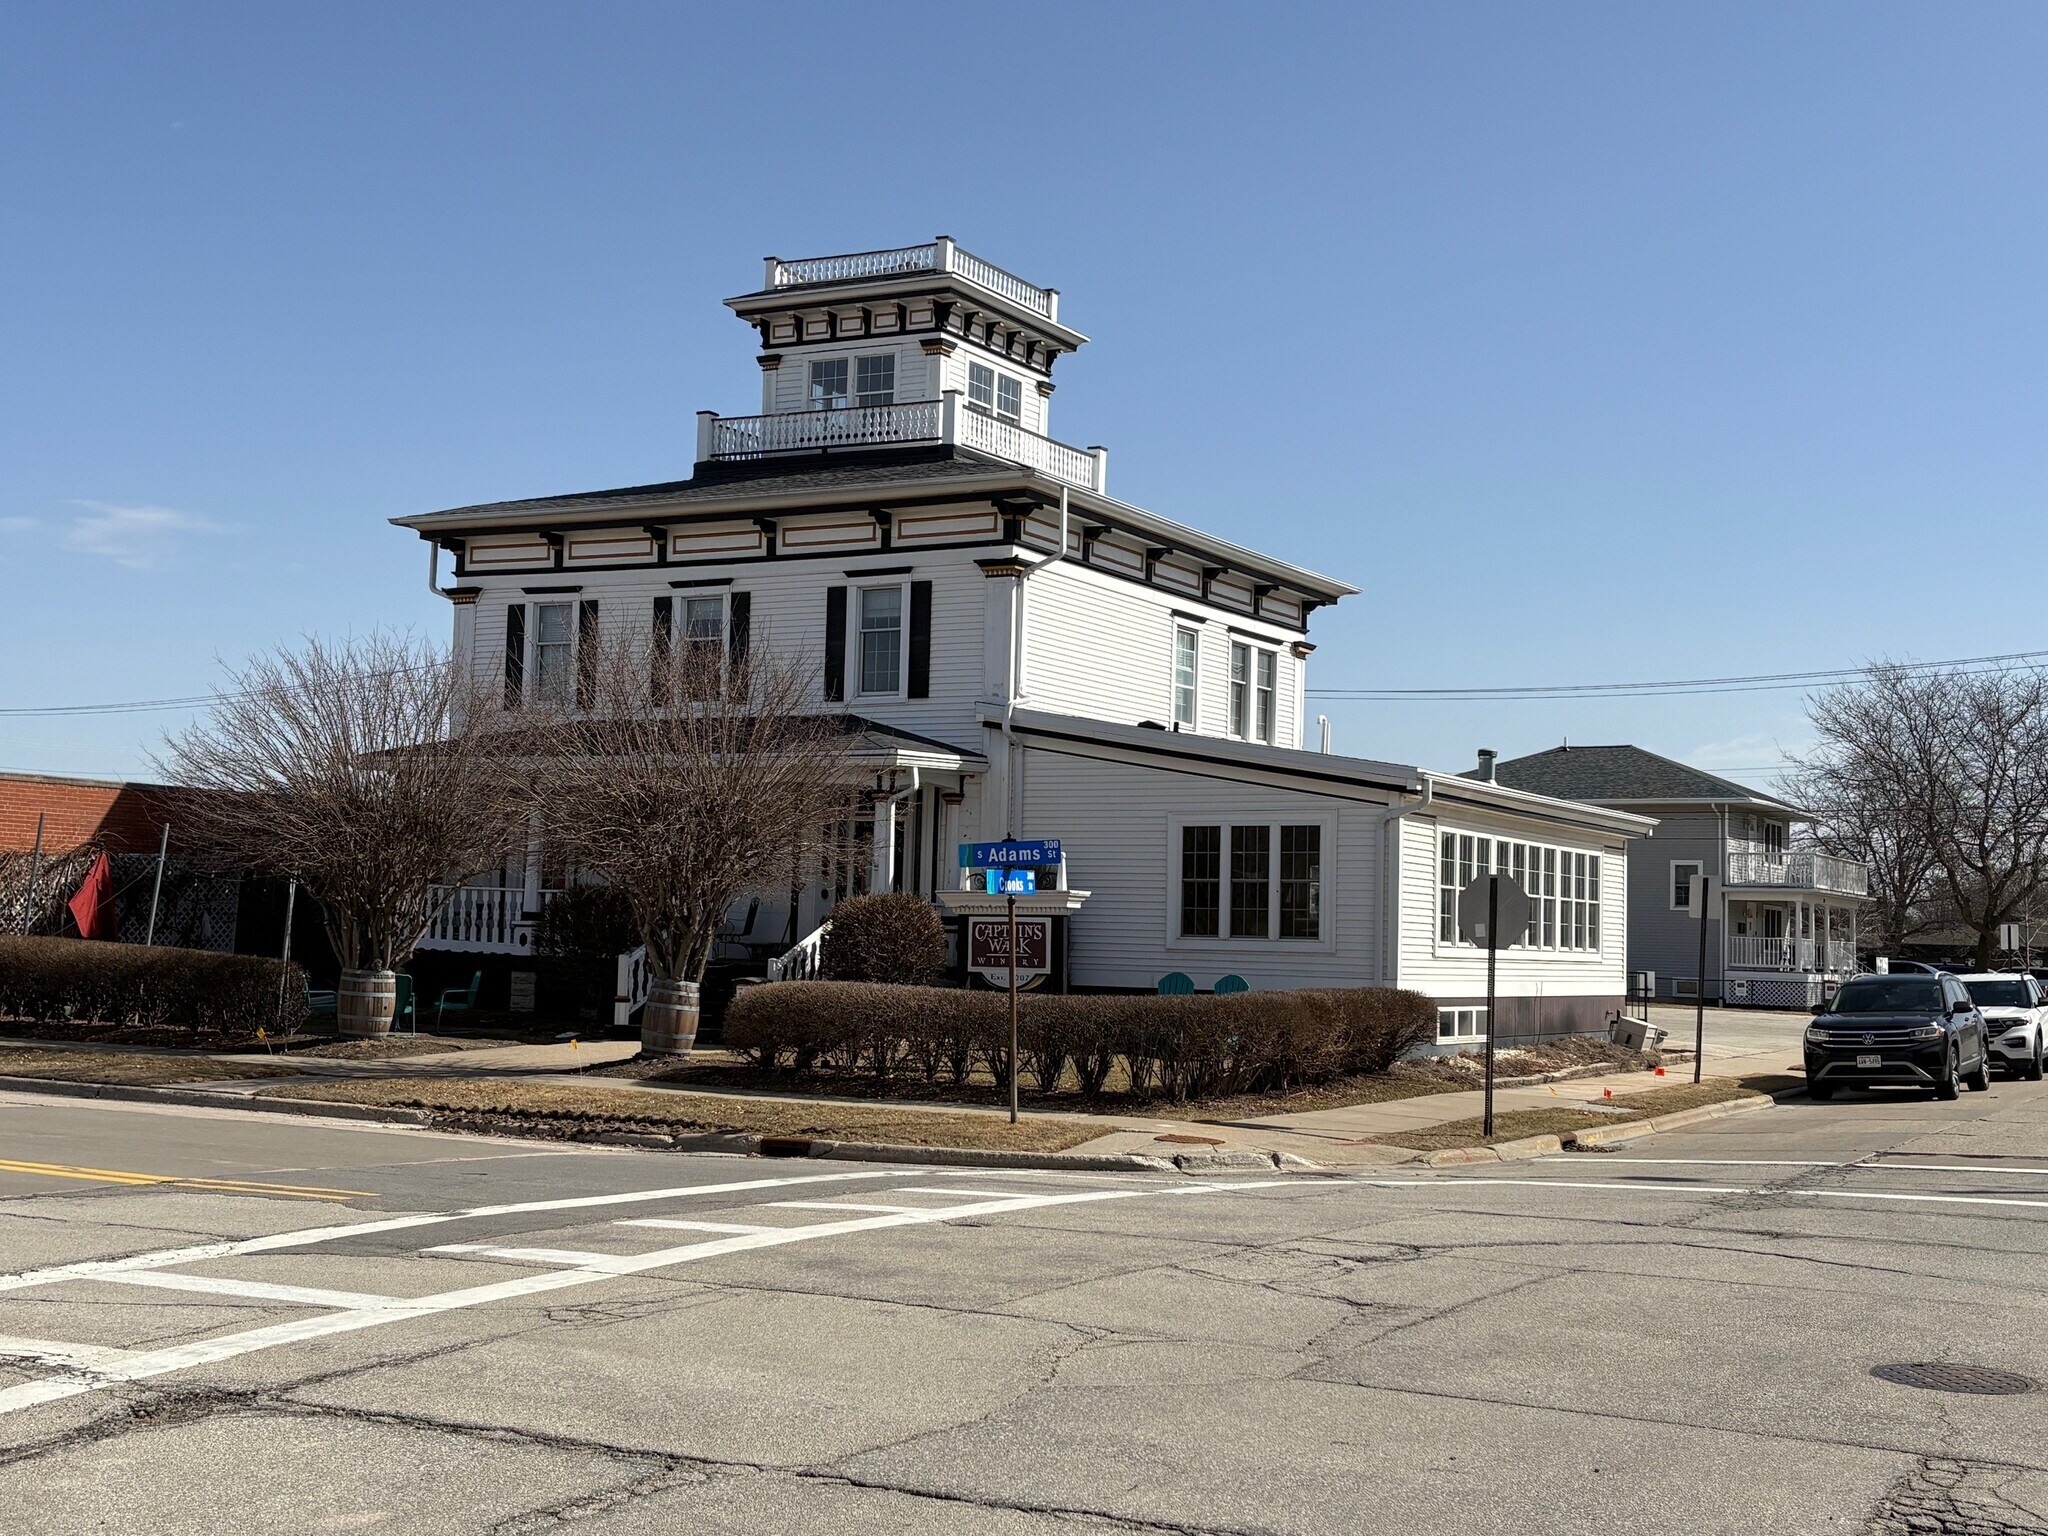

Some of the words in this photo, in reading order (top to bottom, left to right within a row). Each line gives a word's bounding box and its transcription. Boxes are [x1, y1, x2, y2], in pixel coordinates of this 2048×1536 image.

[1043, 840, 1059, 849] 300
[988, 847, 1041, 863] Adams
[1047, 849, 1056, 858] St
[975, 924, 1043, 942] CAPTIN'S
[977, 957, 1039, 966] WINRY
